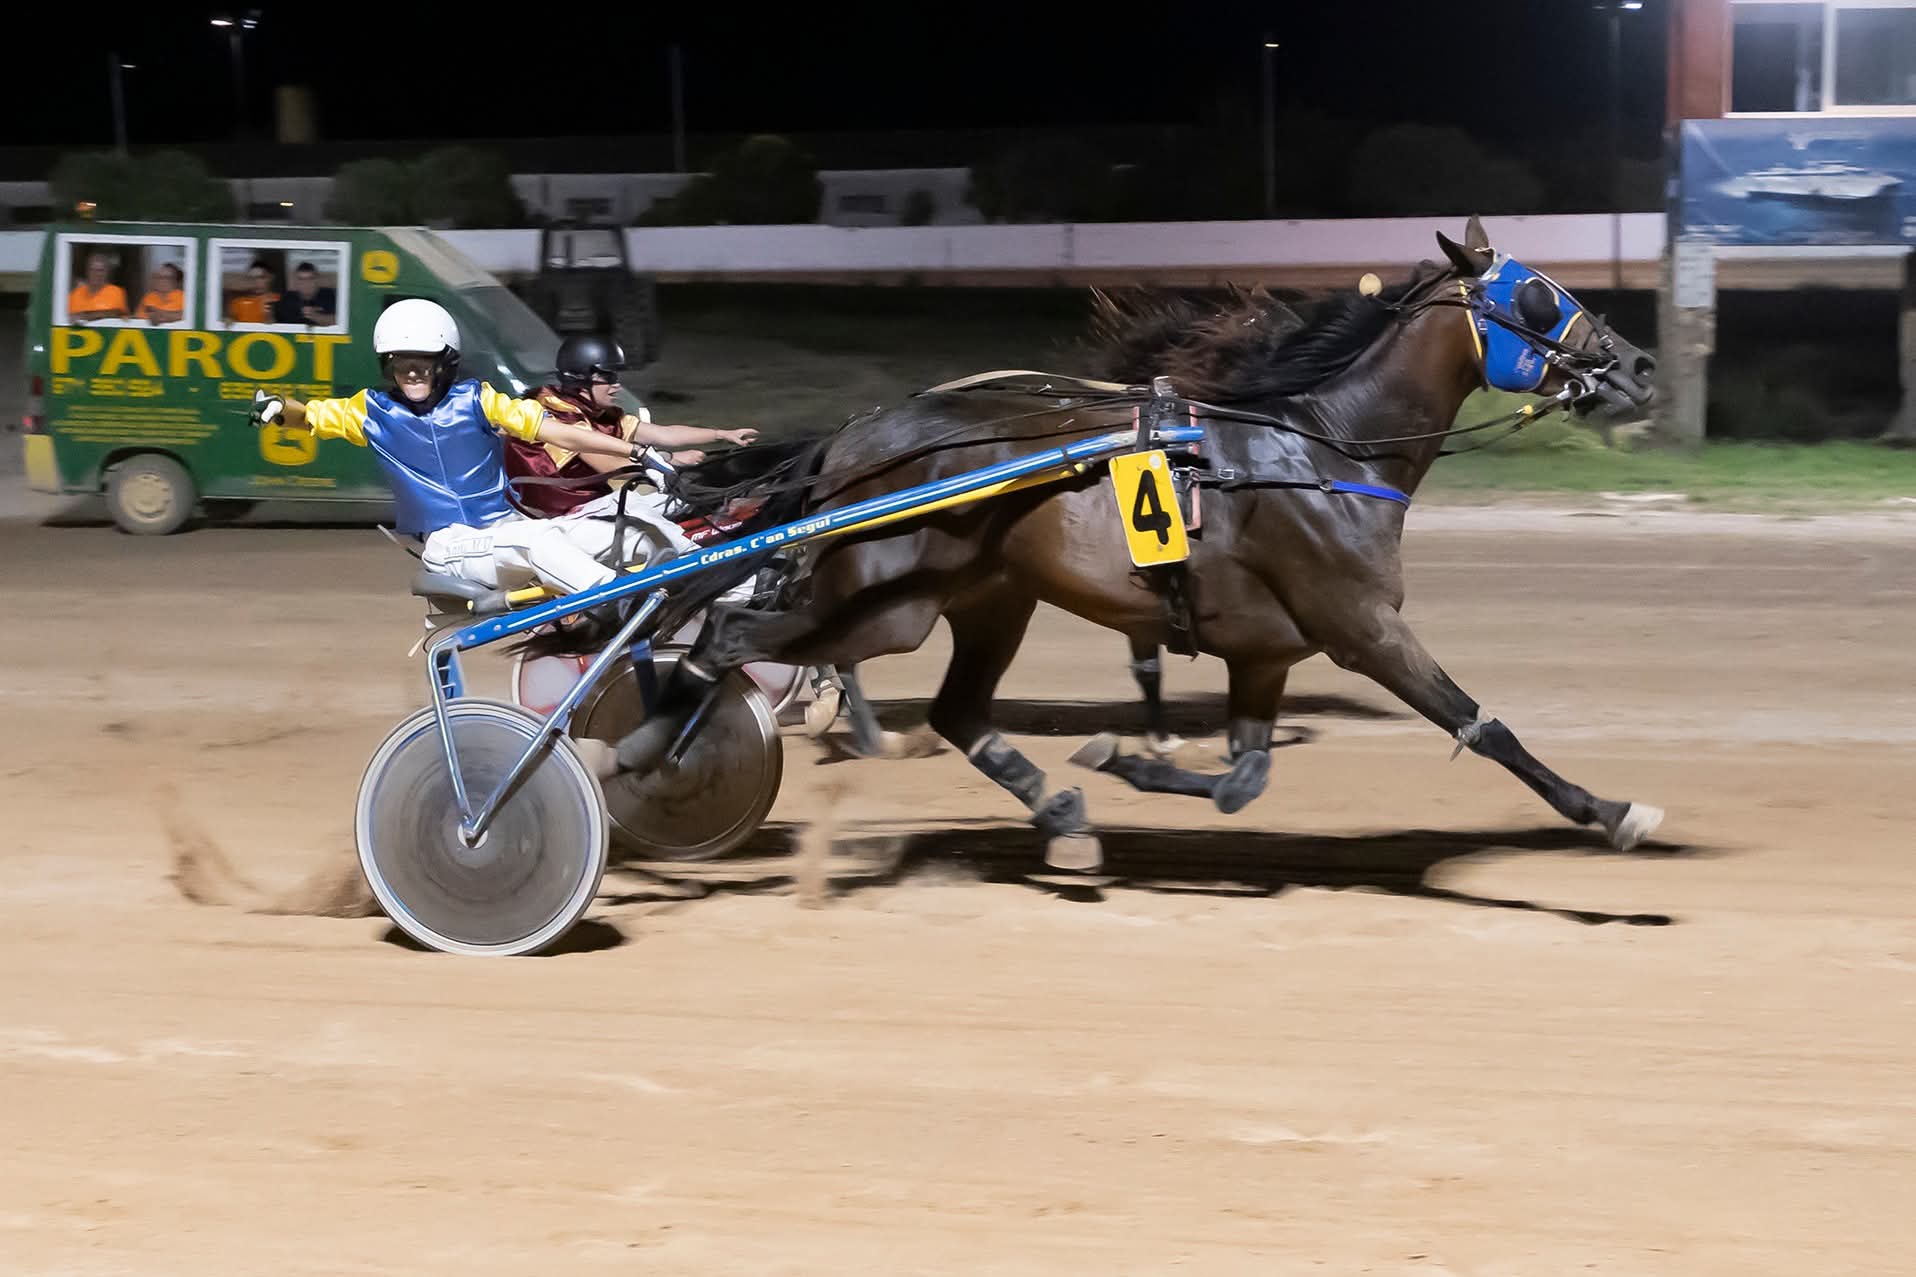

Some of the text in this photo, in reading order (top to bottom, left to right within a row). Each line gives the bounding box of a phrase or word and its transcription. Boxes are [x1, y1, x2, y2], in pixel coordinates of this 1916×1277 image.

[51, 327, 352, 381] PAROT
[1132, 469, 1172, 545] 4
[700, 545, 747, 566] Cdras.
